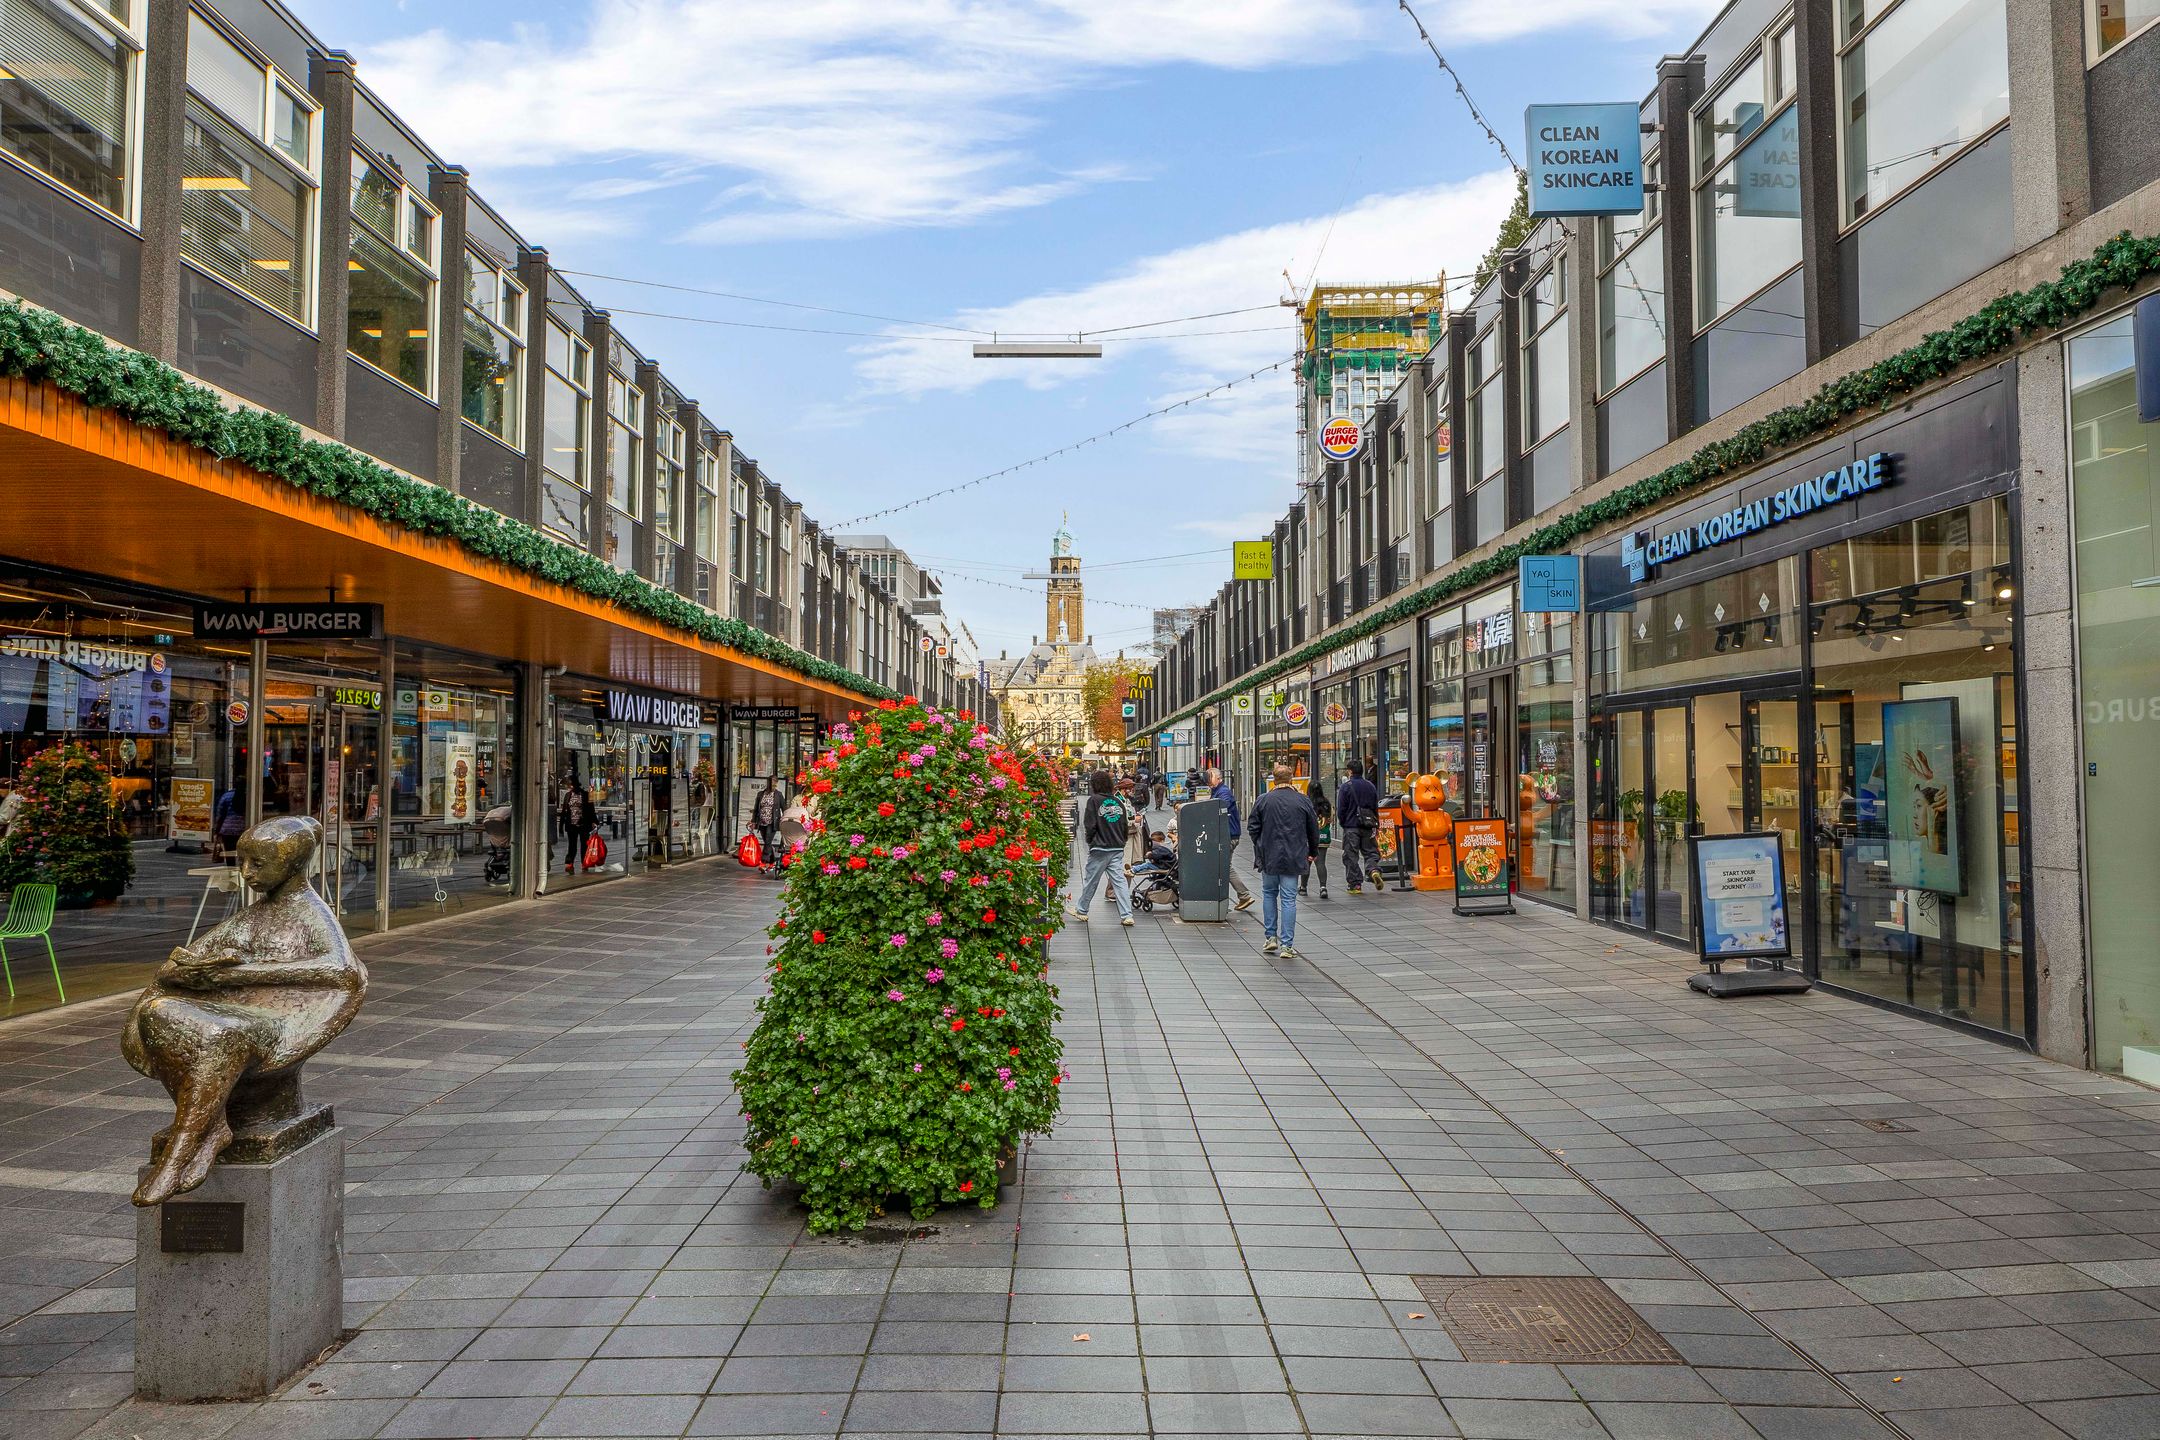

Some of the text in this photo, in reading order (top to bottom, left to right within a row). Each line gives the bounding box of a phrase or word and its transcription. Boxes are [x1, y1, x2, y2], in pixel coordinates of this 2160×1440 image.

[1540, 126, 1599, 142] CLEAN
[1542, 149, 1619, 165] KOREAN
[1543, 172, 1634, 189] SKINCARE
[1325, 427, 1358, 435] BURGER
[1324, 434, 1359, 446] KING
[1647, 453, 1883, 566] CLEAN KOREAN SKINCARE
[1241, 551, 1266, 559] fast &
[1239, 561, 1269, 570] healthy
[1631, 560, 1643, 571] SKIN
[203, 611, 361, 630] WAW BURGER
[1332, 635, 1374, 672] BURGER KING
[609, 691, 700, 728] WAW BURGER
[735, 709, 759, 718] WAW
[1288, 710, 1306, 720] KING
